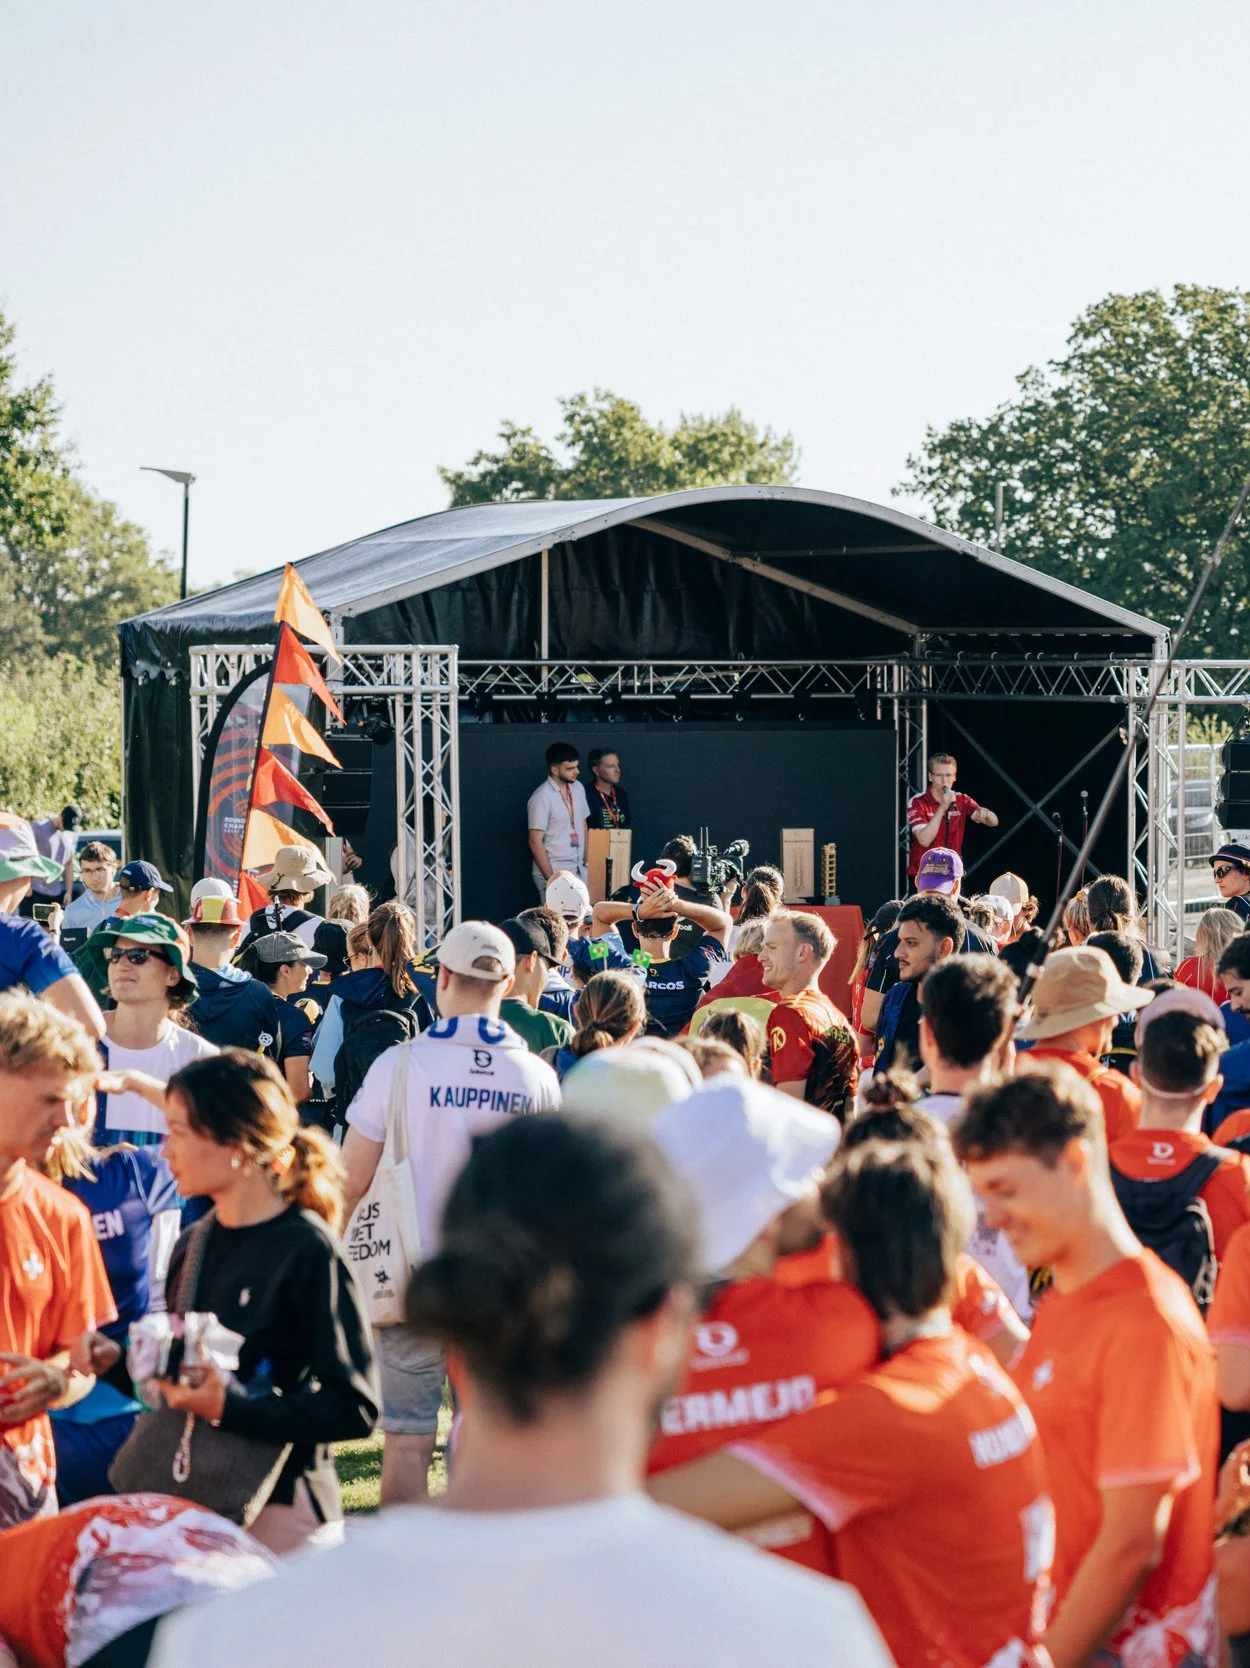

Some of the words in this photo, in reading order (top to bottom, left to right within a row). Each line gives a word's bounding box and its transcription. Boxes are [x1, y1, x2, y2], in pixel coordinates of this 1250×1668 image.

[429, 1086, 532, 1116] KAUPPINEN
[92, 1209, 125, 1240] EN
[661, 1374, 816, 1437] ERMEJO
